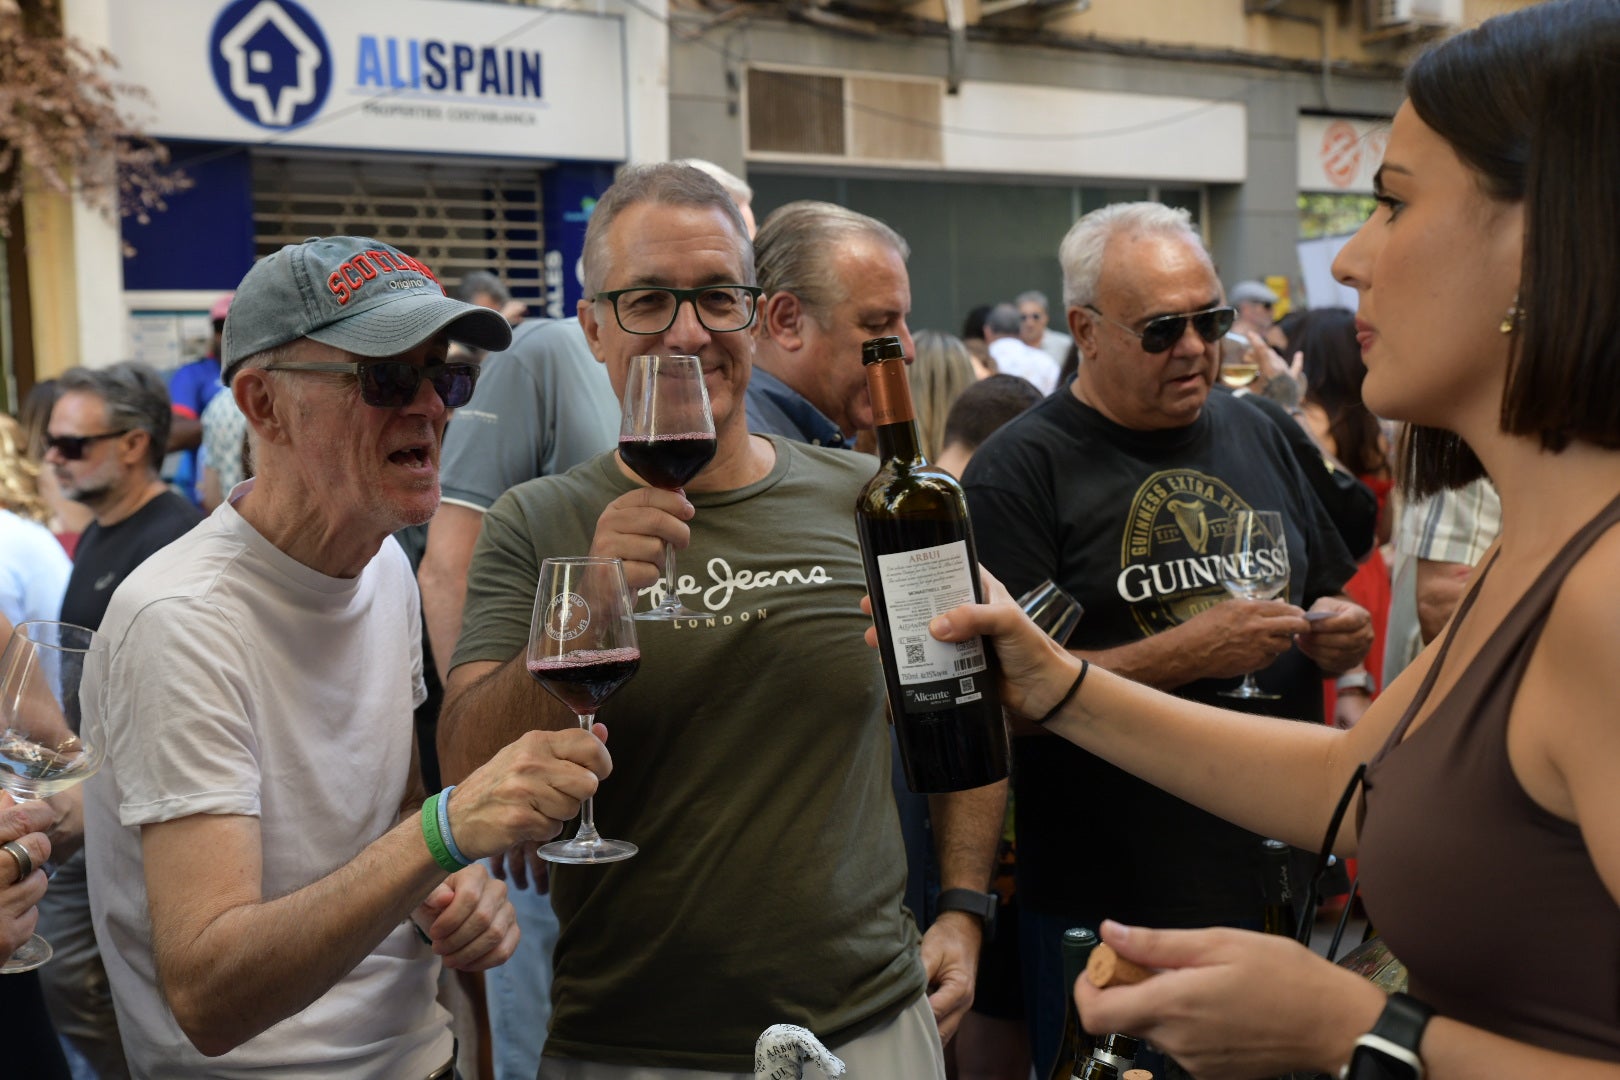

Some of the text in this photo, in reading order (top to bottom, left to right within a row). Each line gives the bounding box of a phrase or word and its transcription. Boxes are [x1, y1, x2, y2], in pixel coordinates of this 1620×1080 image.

[357, 34, 542, 99] ALISPAIN
[1131, 483, 1168, 556] GUINNESS
[1167, 475, 1215, 500] EXTRA
[703, 557, 833, 611] Jeans
[1117, 548, 1286, 603] GUINNESS
[674, 608, 768, 630] LONDON
[913, 690, 950, 703] Alicante
